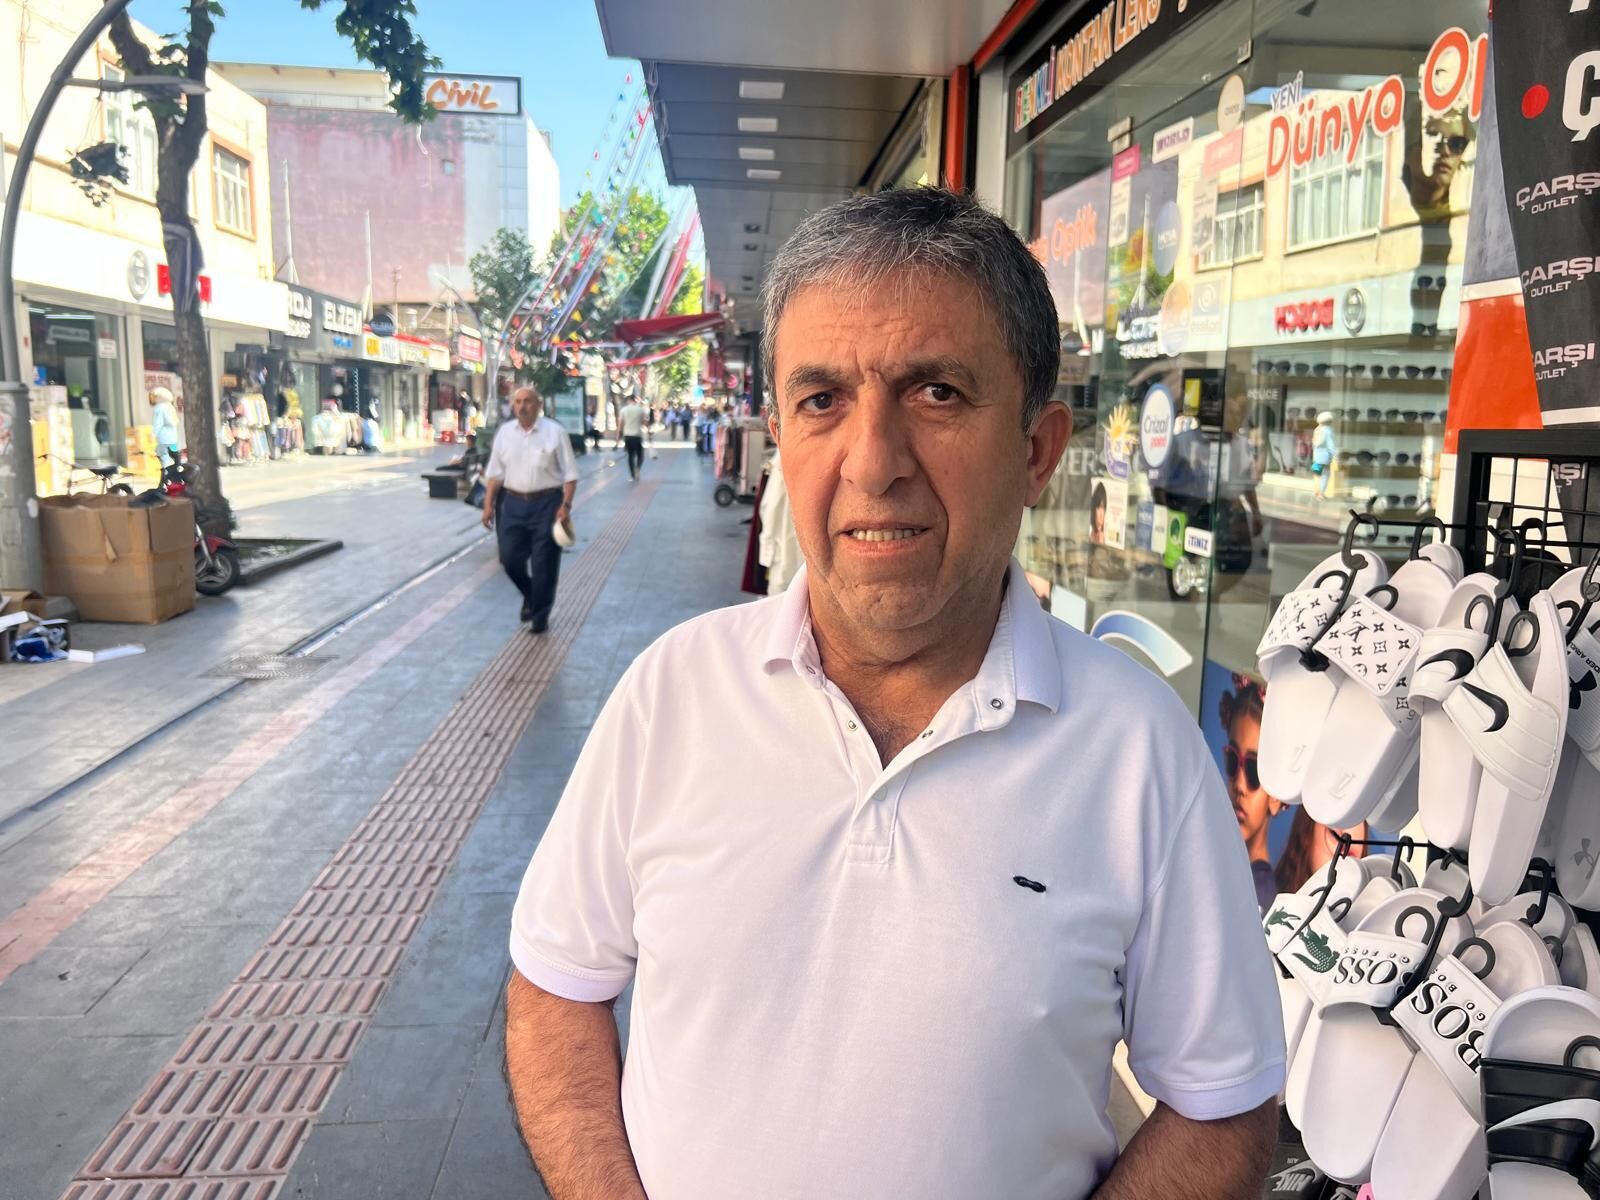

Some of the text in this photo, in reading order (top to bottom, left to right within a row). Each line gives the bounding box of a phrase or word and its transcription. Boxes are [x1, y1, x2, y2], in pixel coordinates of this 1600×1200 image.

[1055, 1, 1115, 100] KONTAK
[1271, 70, 1304, 112] YENİ
[1265, 74, 1405, 178] Dünya
[1516, 172, 1600, 211] ÇARŞ
[1531, 195, 1578, 214] OUTLET
[1530, 281, 1571, 298] OUTLET
[1532, 343, 1596, 368] ARŞI
[1410, 977, 1485, 1074] BOS
[1272, 1173, 1314, 1192] NIKE
